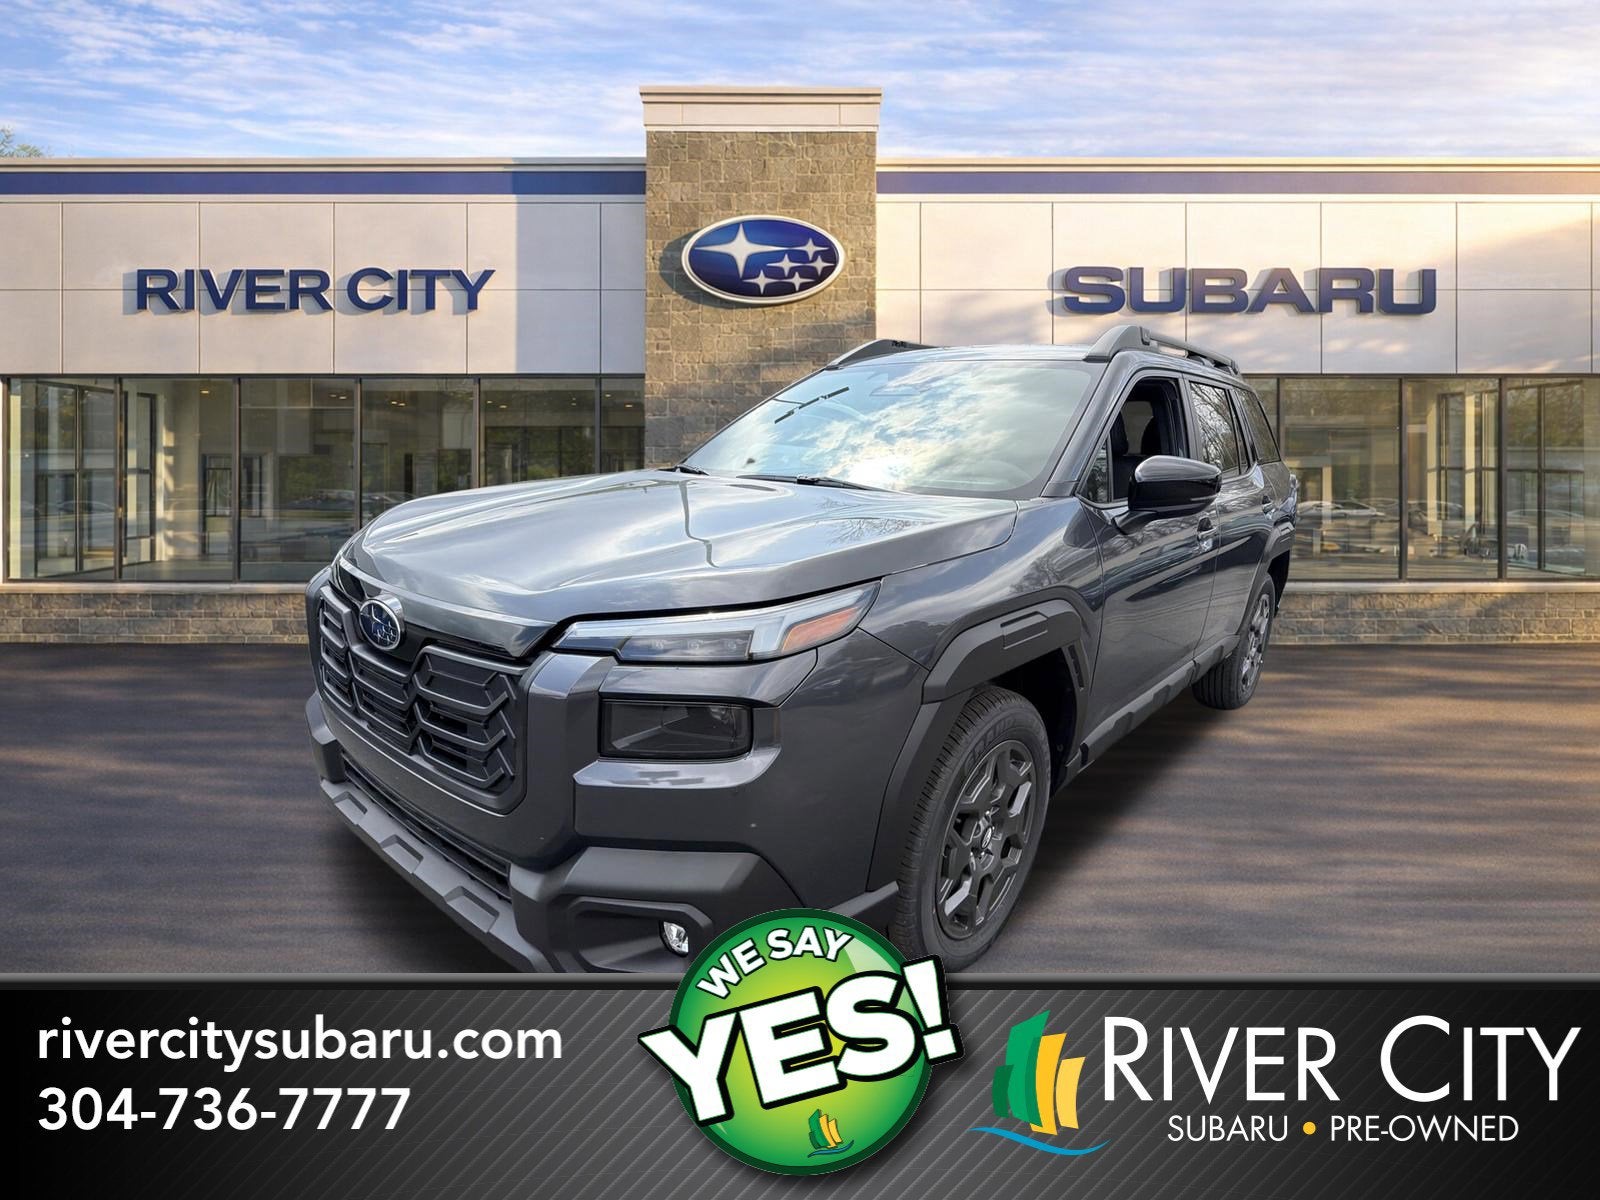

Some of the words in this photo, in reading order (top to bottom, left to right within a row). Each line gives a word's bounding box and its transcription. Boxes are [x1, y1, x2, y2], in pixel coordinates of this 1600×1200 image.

[136, 267, 334, 312] RIVER
[346, 267, 496, 312] CITY
[1063, 266, 1437, 315] SUBARU
